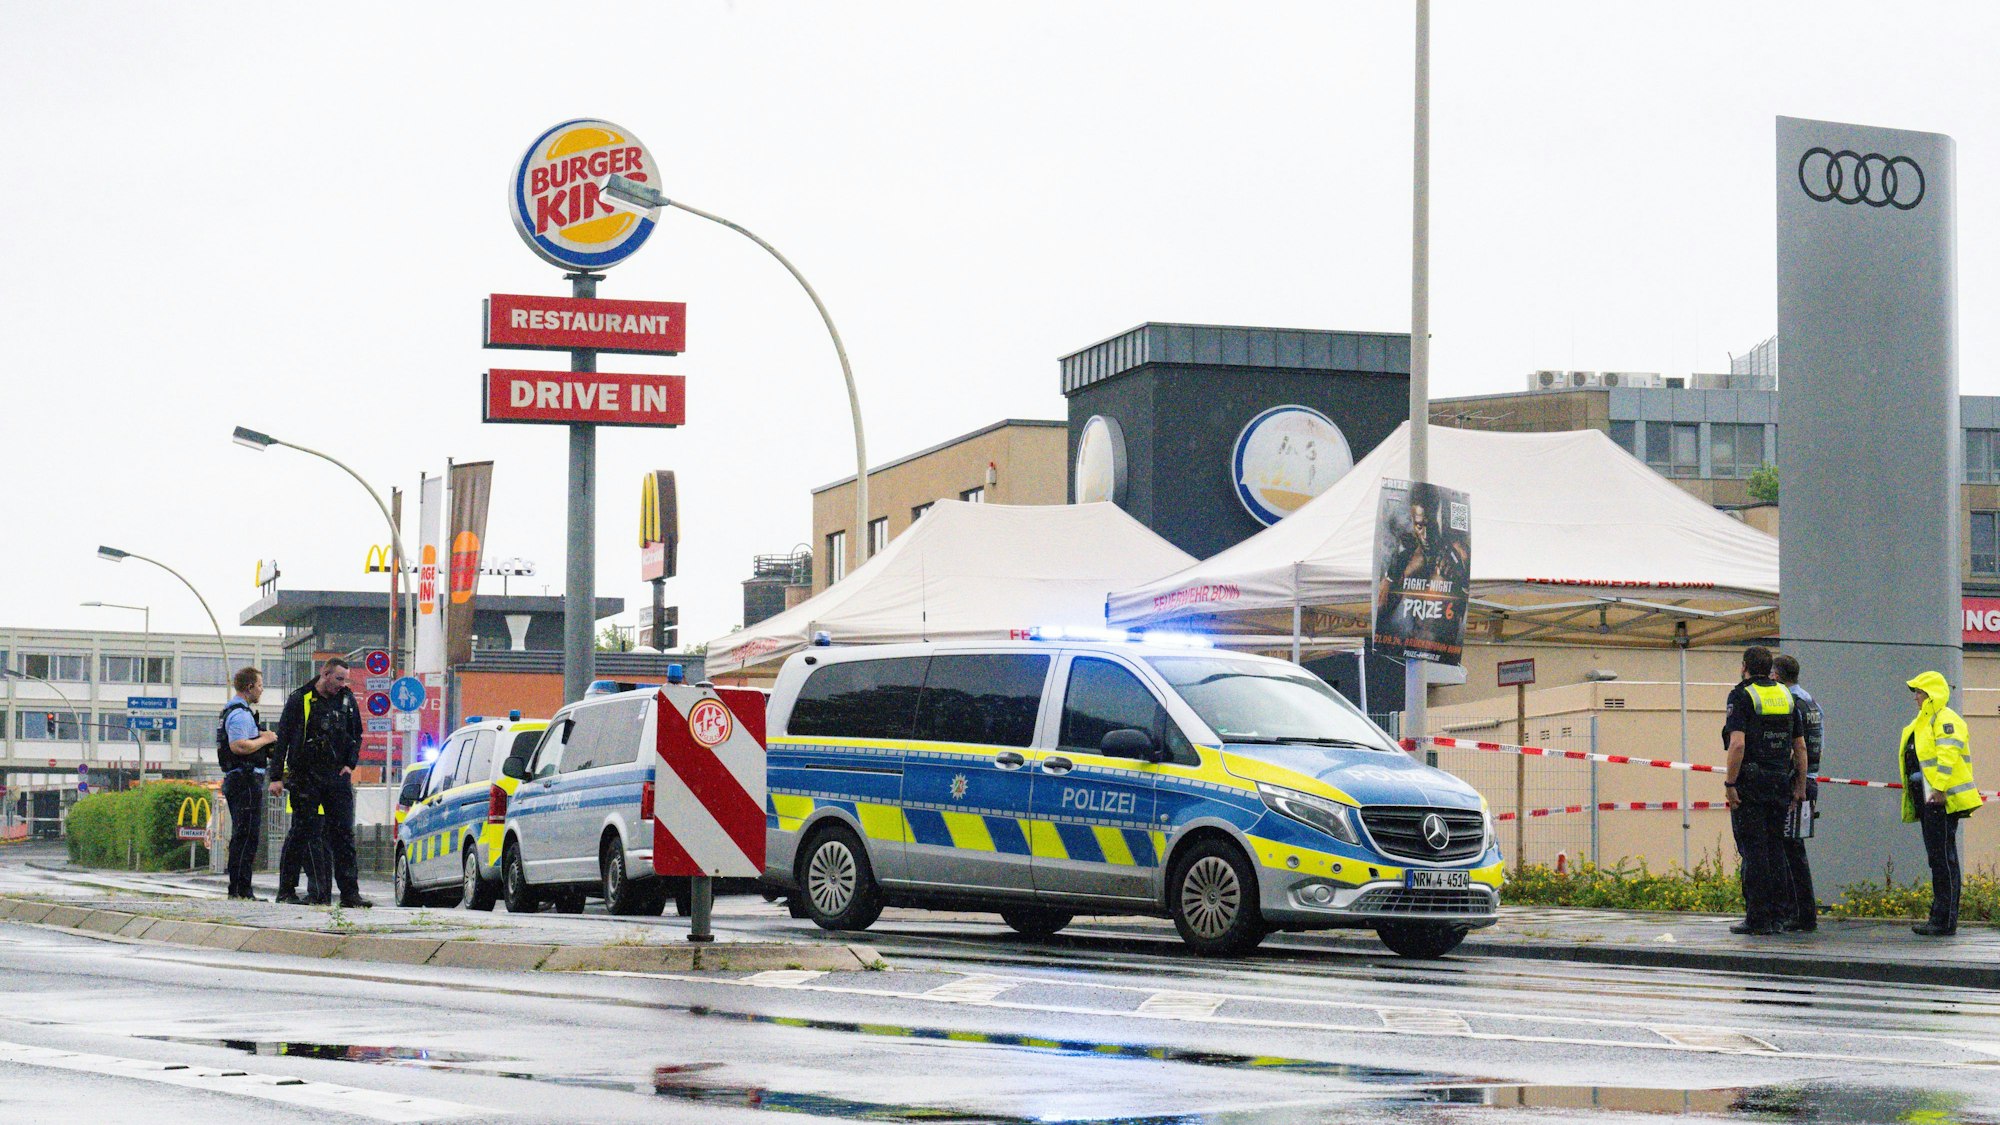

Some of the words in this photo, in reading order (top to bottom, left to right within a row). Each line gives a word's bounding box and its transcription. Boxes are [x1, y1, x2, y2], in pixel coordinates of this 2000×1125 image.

[531, 146, 644, 196] BURGER
[535, 172, 648, 237] KIN
[511, 308, 670, 336] RESTAURANT
[510, 379, 620, 411] DRIVE
[631, 384, 667, 413] IN
[1154, 585, 1210, 609] FEUERWEHR
[1211, 583, 1240, 601] BONN
[1403, 577, 1453, 593] FIGHT-NIGHT
[1403, 598, 1443, 621] PRIZE
[1445, 602, 1455, 620] 6
[1061, 787, 1137, 814] POLIZEI
[1412, 871, 1432, 888] NRW
[1436, 870, 1468, 888] 4-4514
